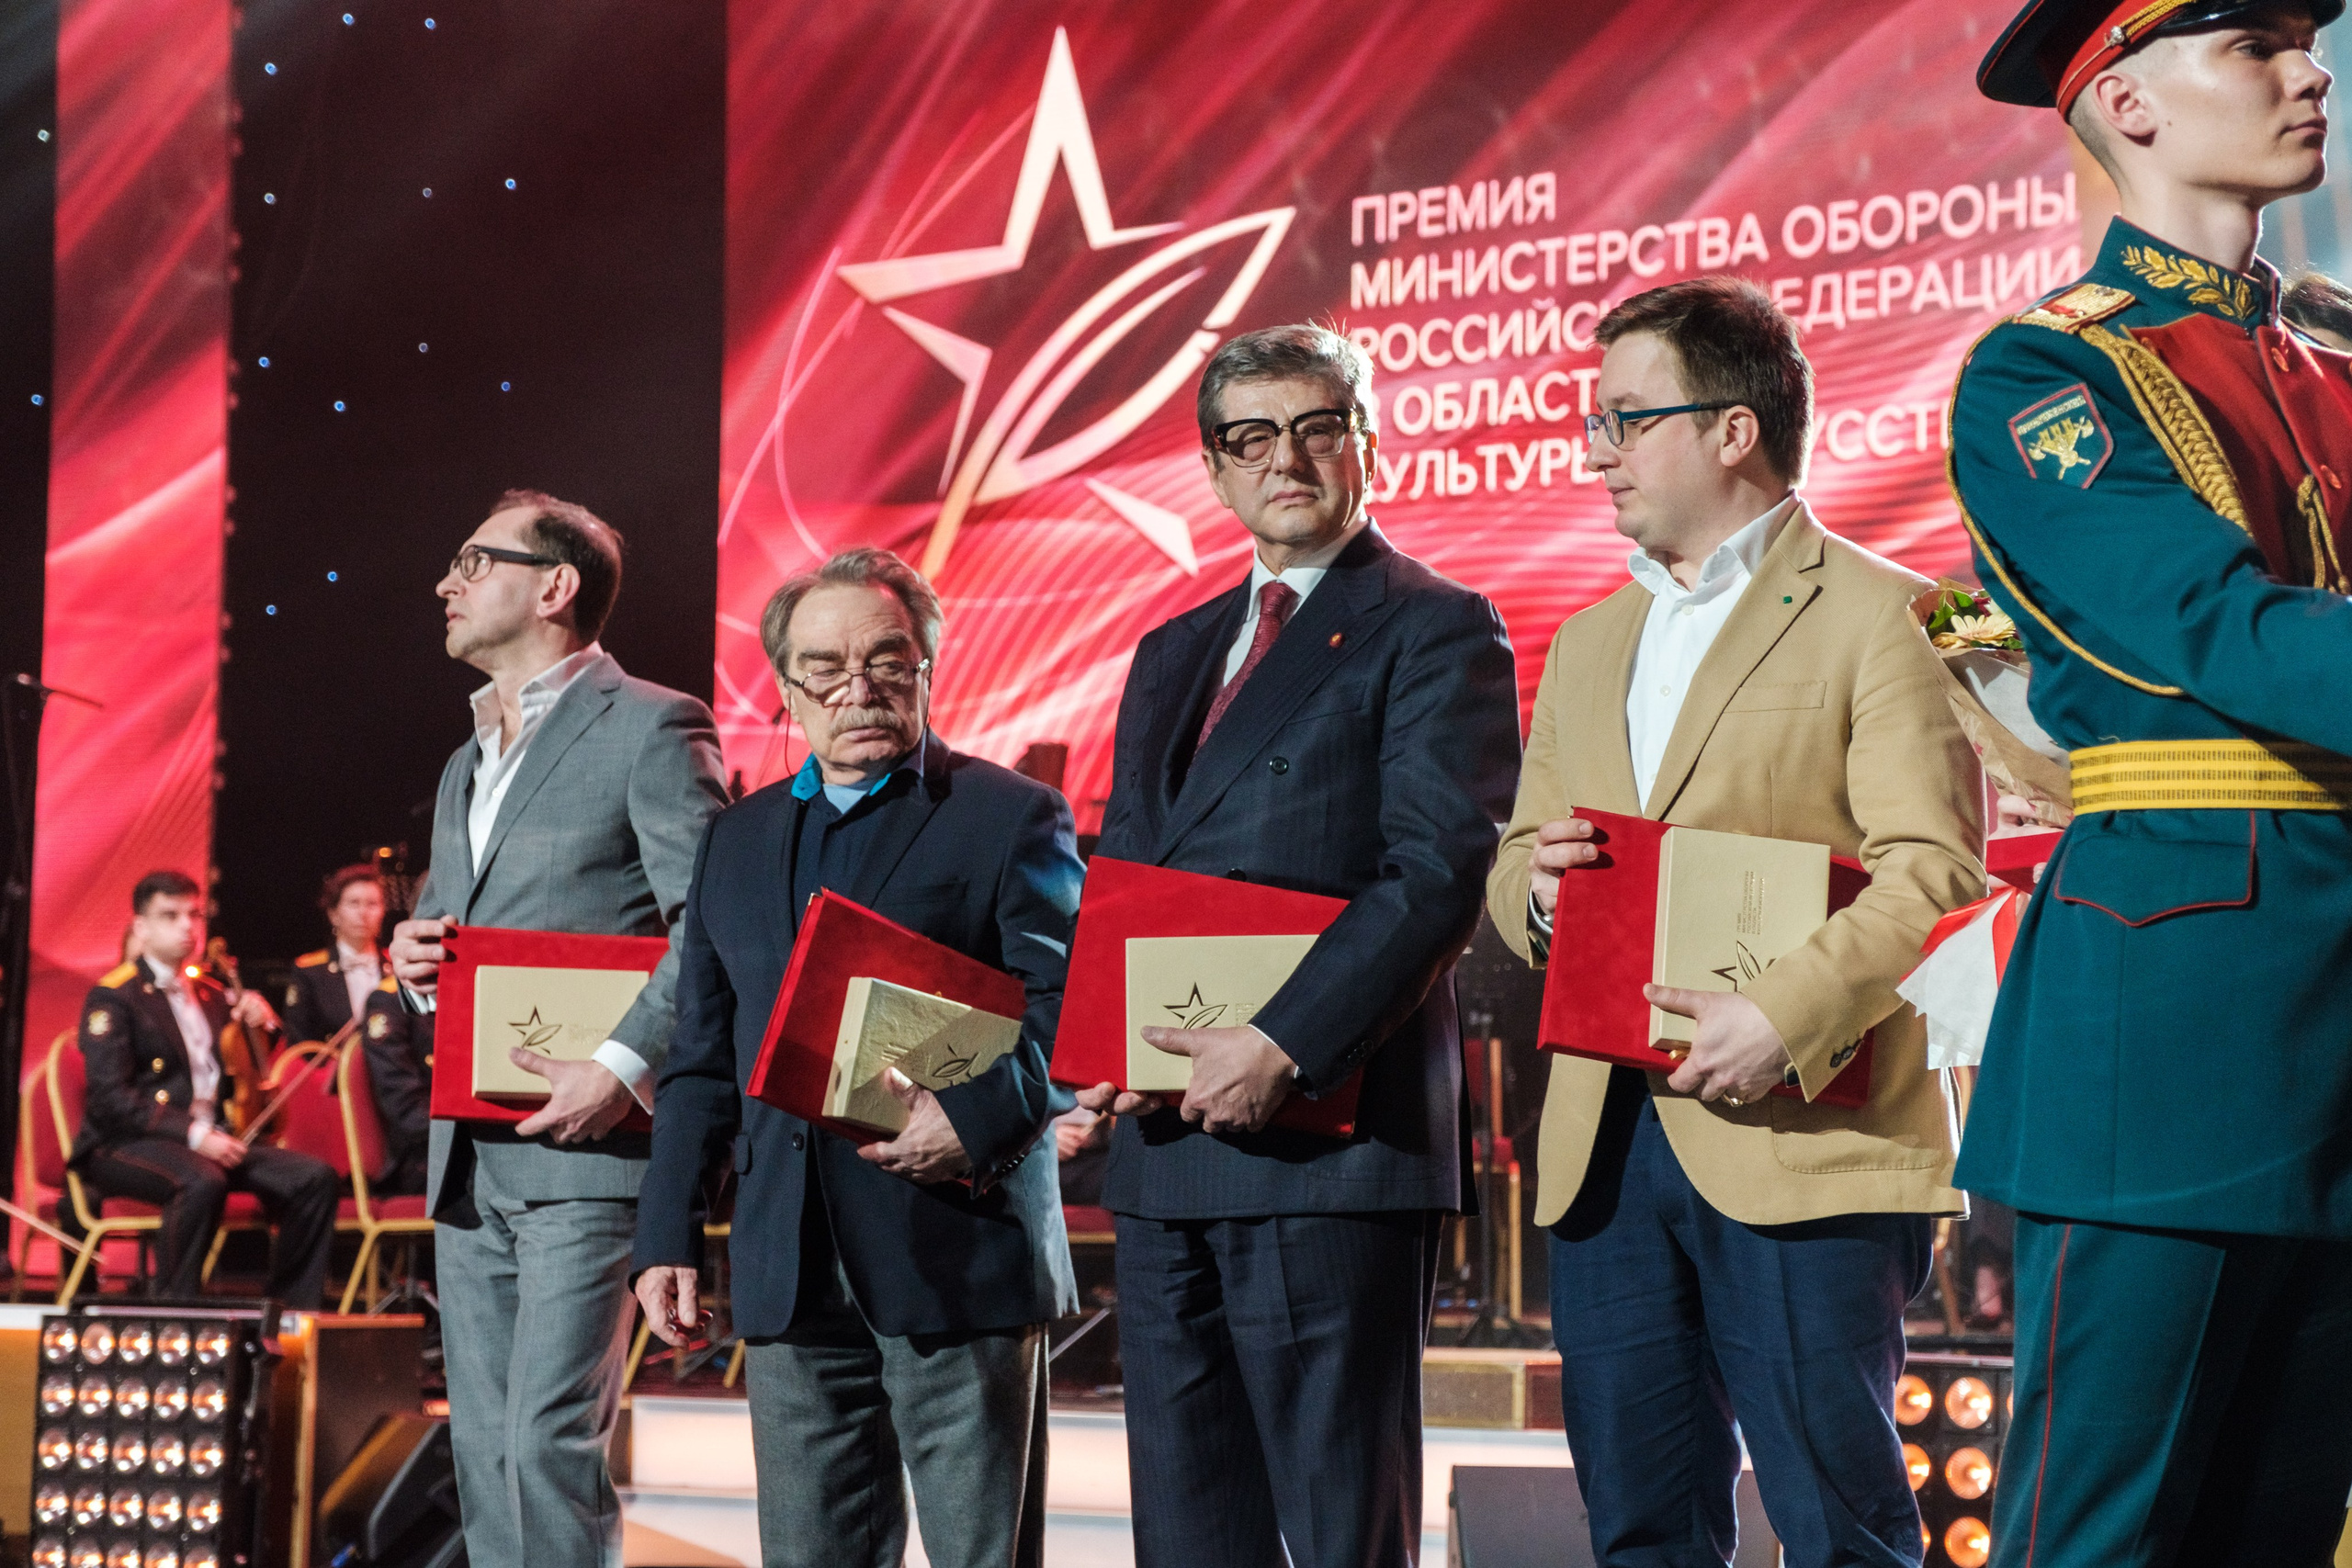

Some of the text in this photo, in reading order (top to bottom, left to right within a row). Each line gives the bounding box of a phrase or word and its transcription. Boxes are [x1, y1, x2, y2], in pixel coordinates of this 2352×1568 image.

[1350, 172, 2076, 310] МИНИСТЕРСТВА ОБОРОНЫ
[1351, 171, 1556, 246] ПРЕМИЯ
[1350, 245, 2081, 373] РОССИЙС ЕДЕРАЦИИ
[1393, 367, 1600, 435] ОБЛАСТ
